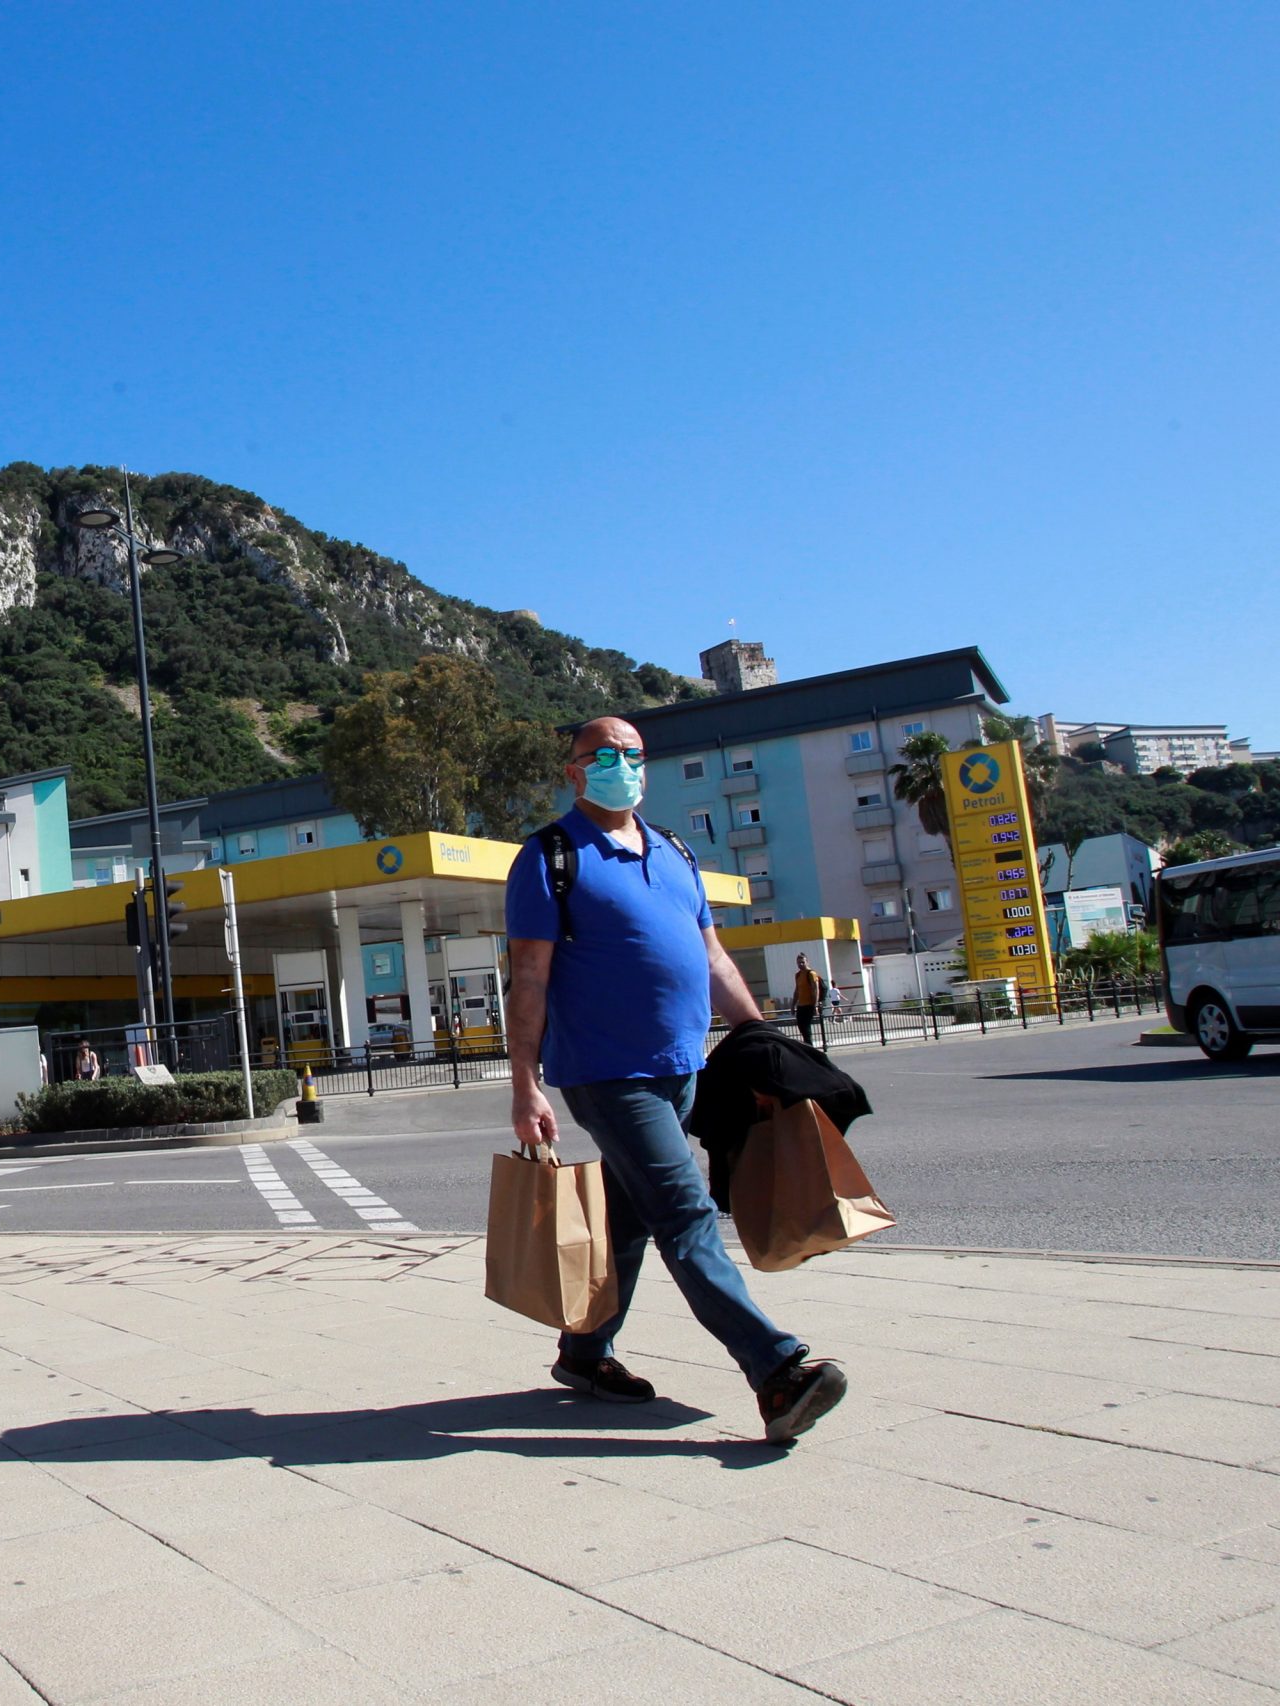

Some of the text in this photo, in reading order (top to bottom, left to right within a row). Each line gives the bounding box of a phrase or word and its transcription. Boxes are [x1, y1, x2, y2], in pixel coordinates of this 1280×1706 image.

[963, 792, 1005, 811] Petroil
[989, 812, 1018, 827] 0.826
[992, 830, 1020, 844] 0.942
[440, 842, 471, 863] Petroil
[997, 867, 1026, 881] 0.969
[1001, 887, 1029, 901] 0.877
[1006, 905, 1032, 919] 1.000
[1012, 943, 1038, 956] 1.030
